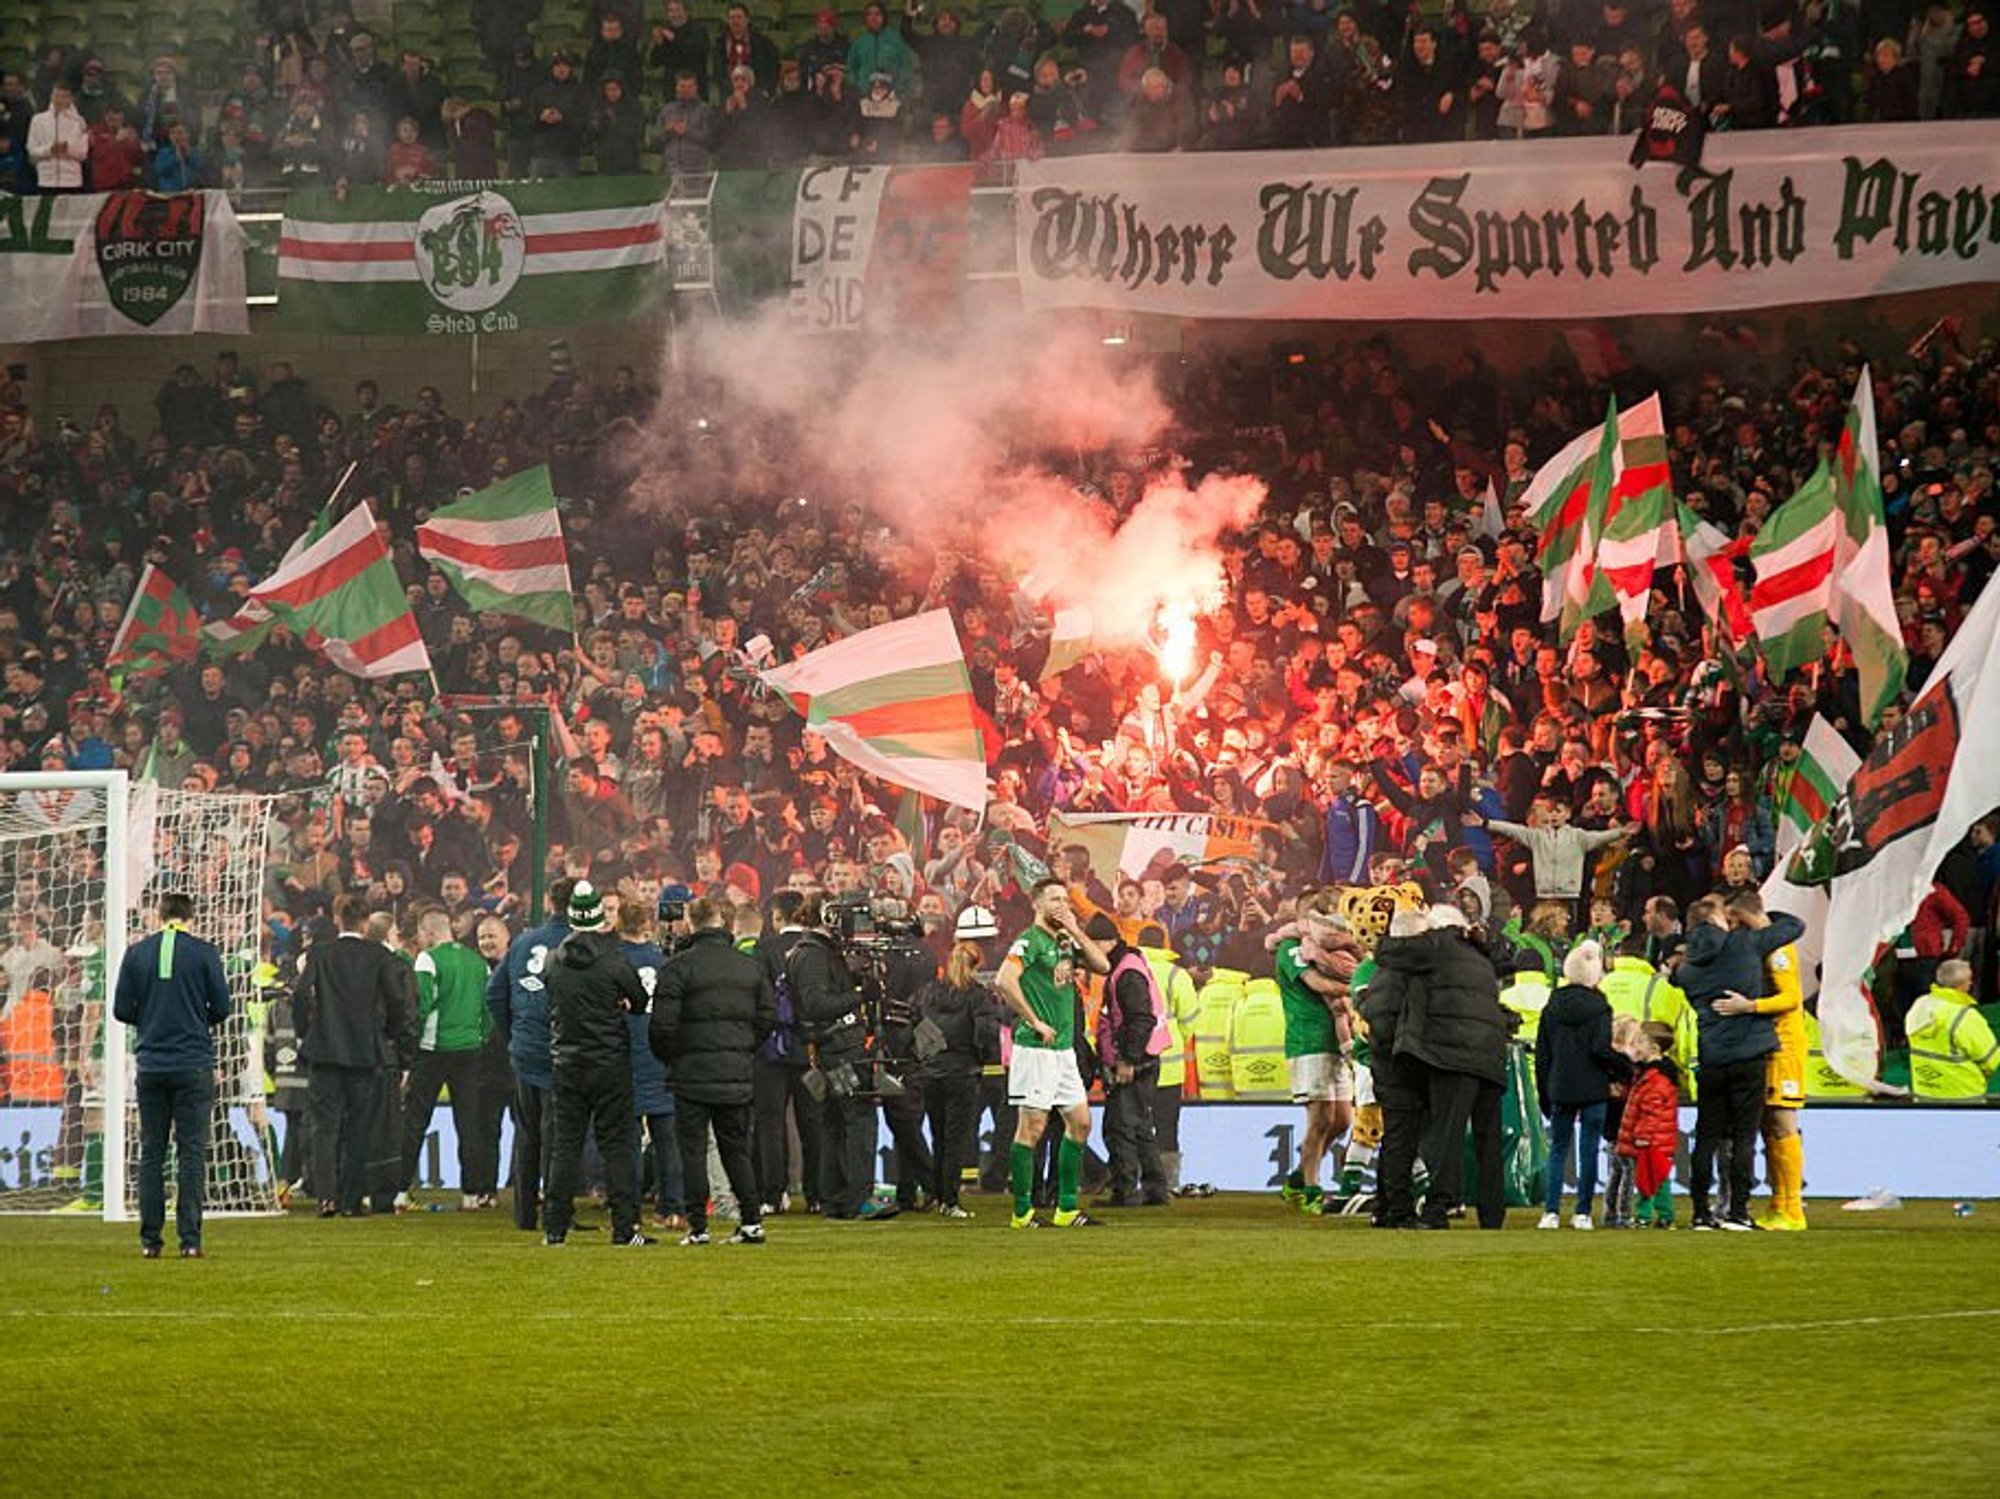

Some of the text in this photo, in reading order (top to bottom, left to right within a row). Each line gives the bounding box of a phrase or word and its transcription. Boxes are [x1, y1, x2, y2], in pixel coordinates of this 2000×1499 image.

[1030, 187, 1236, 290] Where
[1257, 181, 1387, 281] We
[1408, 172, 1659, 294] Sported
[1675, 168, 1806, 272] And
[103, 240, 195, 260] CORK CITY
[123, 286, 168, 302] 1984
[426, 311, 519, 335] Shed End
